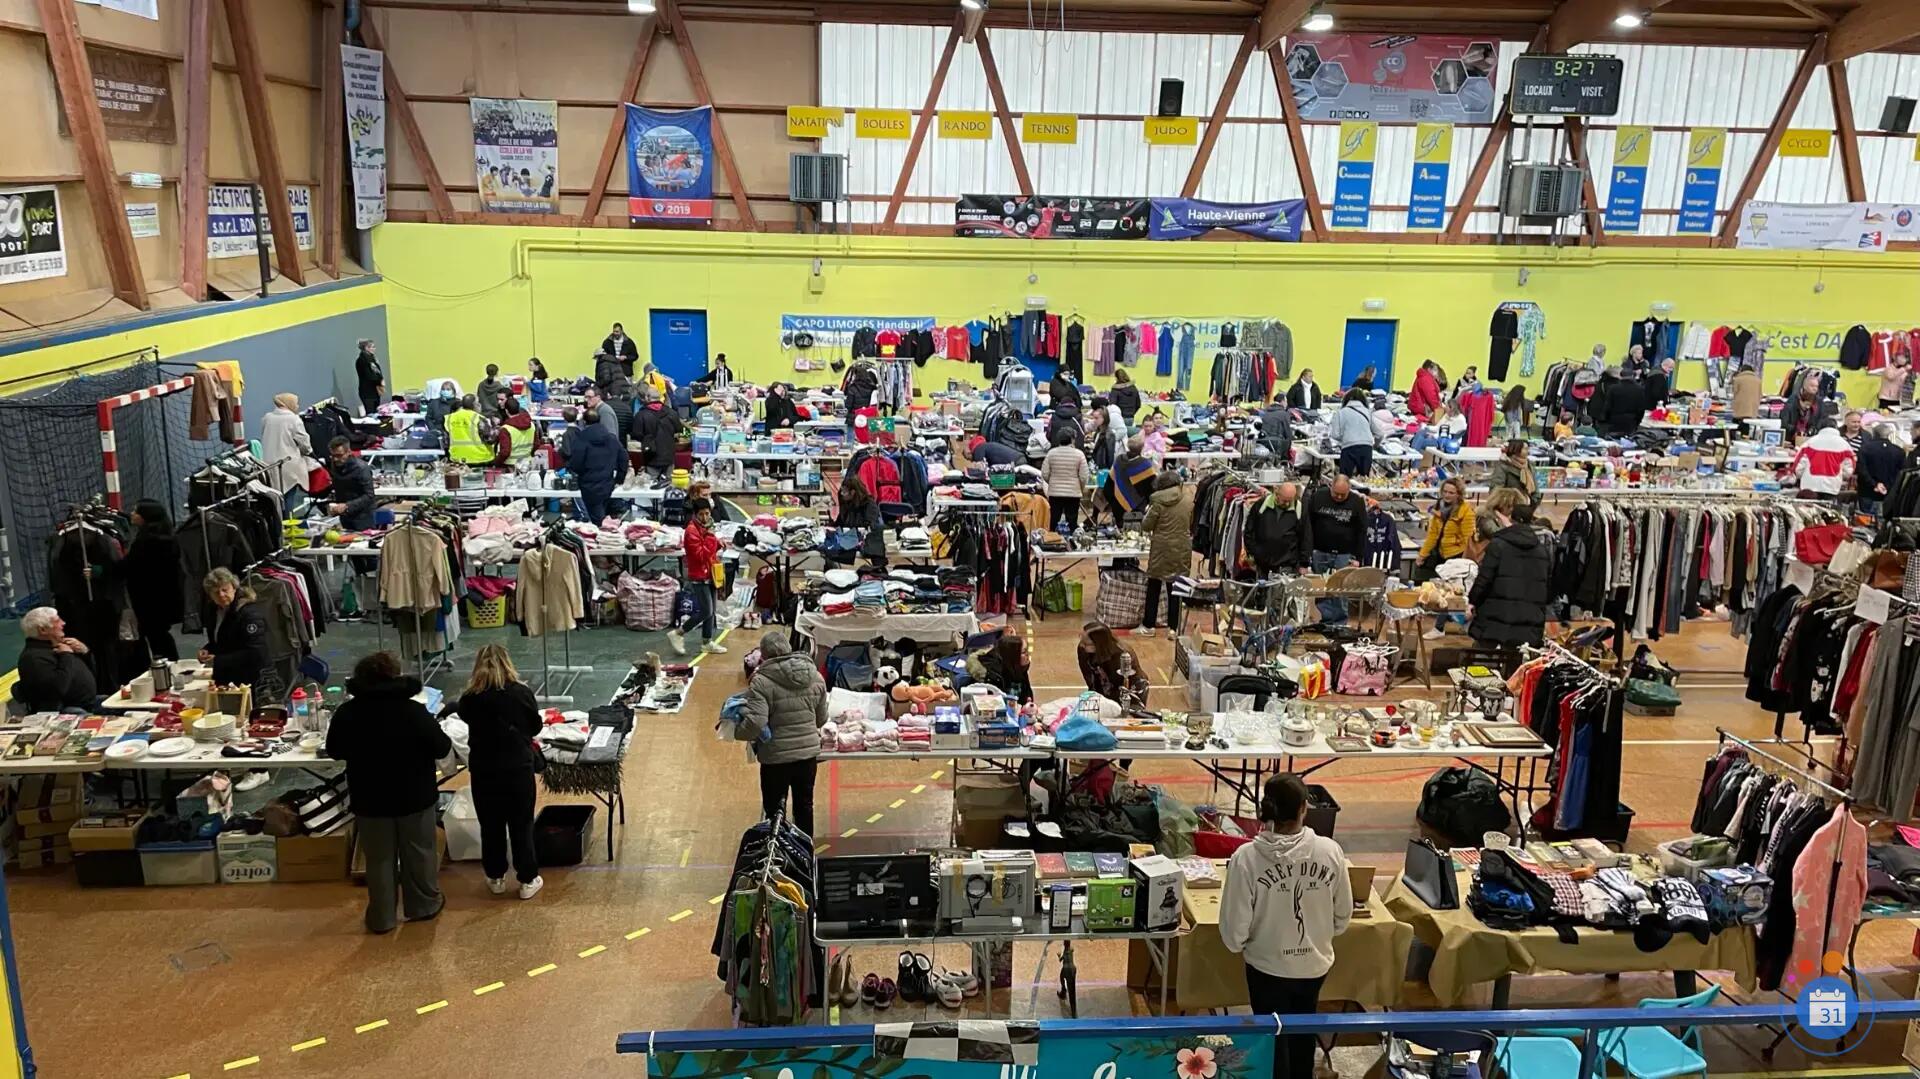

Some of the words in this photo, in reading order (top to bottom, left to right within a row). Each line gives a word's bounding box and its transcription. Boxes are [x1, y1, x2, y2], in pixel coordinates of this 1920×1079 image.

[1555, 61, 1594, 76] 9:27
[1524, 85, 1554, 96] LOCAUX
[1581, 86, 1603, 97] VISIT.
[790, 117, 841, 128] NATATION
[863, 119, 904, 130] BOULES
[944, 120, 986, 131] RANDO
[1031, 123, 1070, 134] TENNIS
[1154, 127, 1188, 136] JUDO
[1787, 137, 1822, 148] CYCLO
[208, 188, 262, 207] LECTRICE
[667, 205, 691, 214] 2019
[1187, 209, 1266, 221] Haute-Vienne
[31, 222, 54, 236] SPORT
[0, 240, 27, 252] PORT
[795, 318, 825, 328] CAPO
[827, 319, 875, 329] LIMOGES
[876, 319, 924, 330] Handball
[1767, 330, 1809, 349] c'est
[1257, 863, 1293, 889] DEEP
